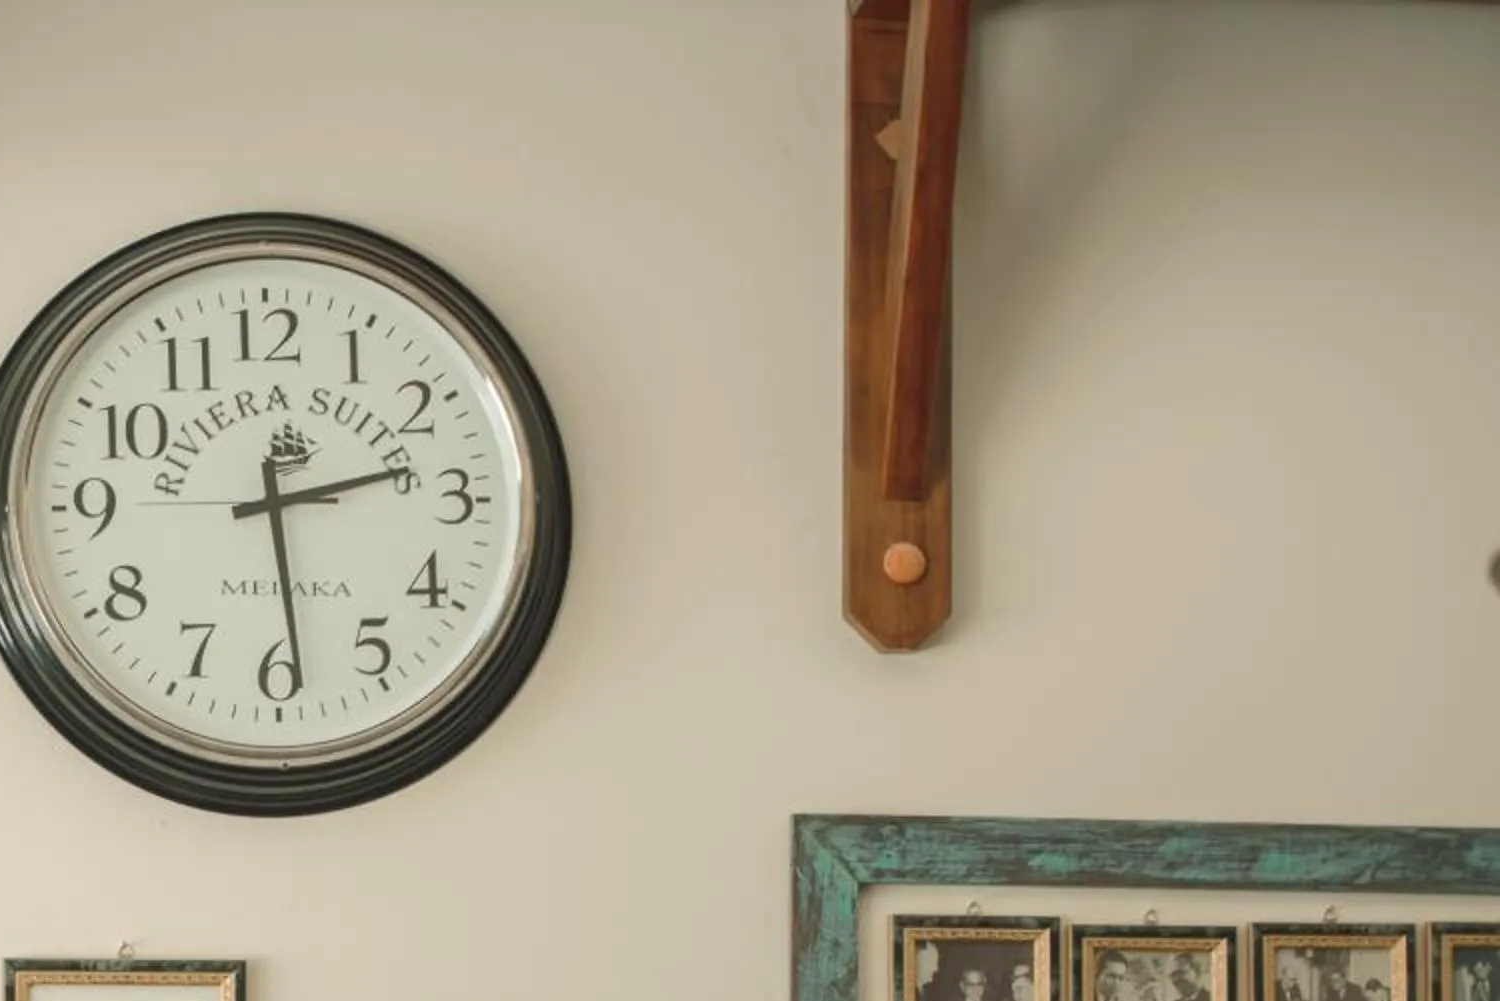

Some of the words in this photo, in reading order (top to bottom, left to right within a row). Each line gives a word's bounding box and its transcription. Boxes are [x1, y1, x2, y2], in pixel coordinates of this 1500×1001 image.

[159, 336, 219, 392] 11
[232, 308, 301, 364] 12
[339, 330, 366, 385] 1
[100, 403, 169, 460] 10
[396, 379, 436, 439] 2
[153, 384, 292, 498] RIVIERA
[307, 387, 422, 496] SUITES
[72, 477, 117, 542] 9
[434, 467, 475, 526] 3
[103, 564, 148, 622] 8
[405, 549, 450, 609] 4
[179, 621, 218, 679] 7
[257, 639, 302, 702] 6
[354, 616, 392, 677] 5
